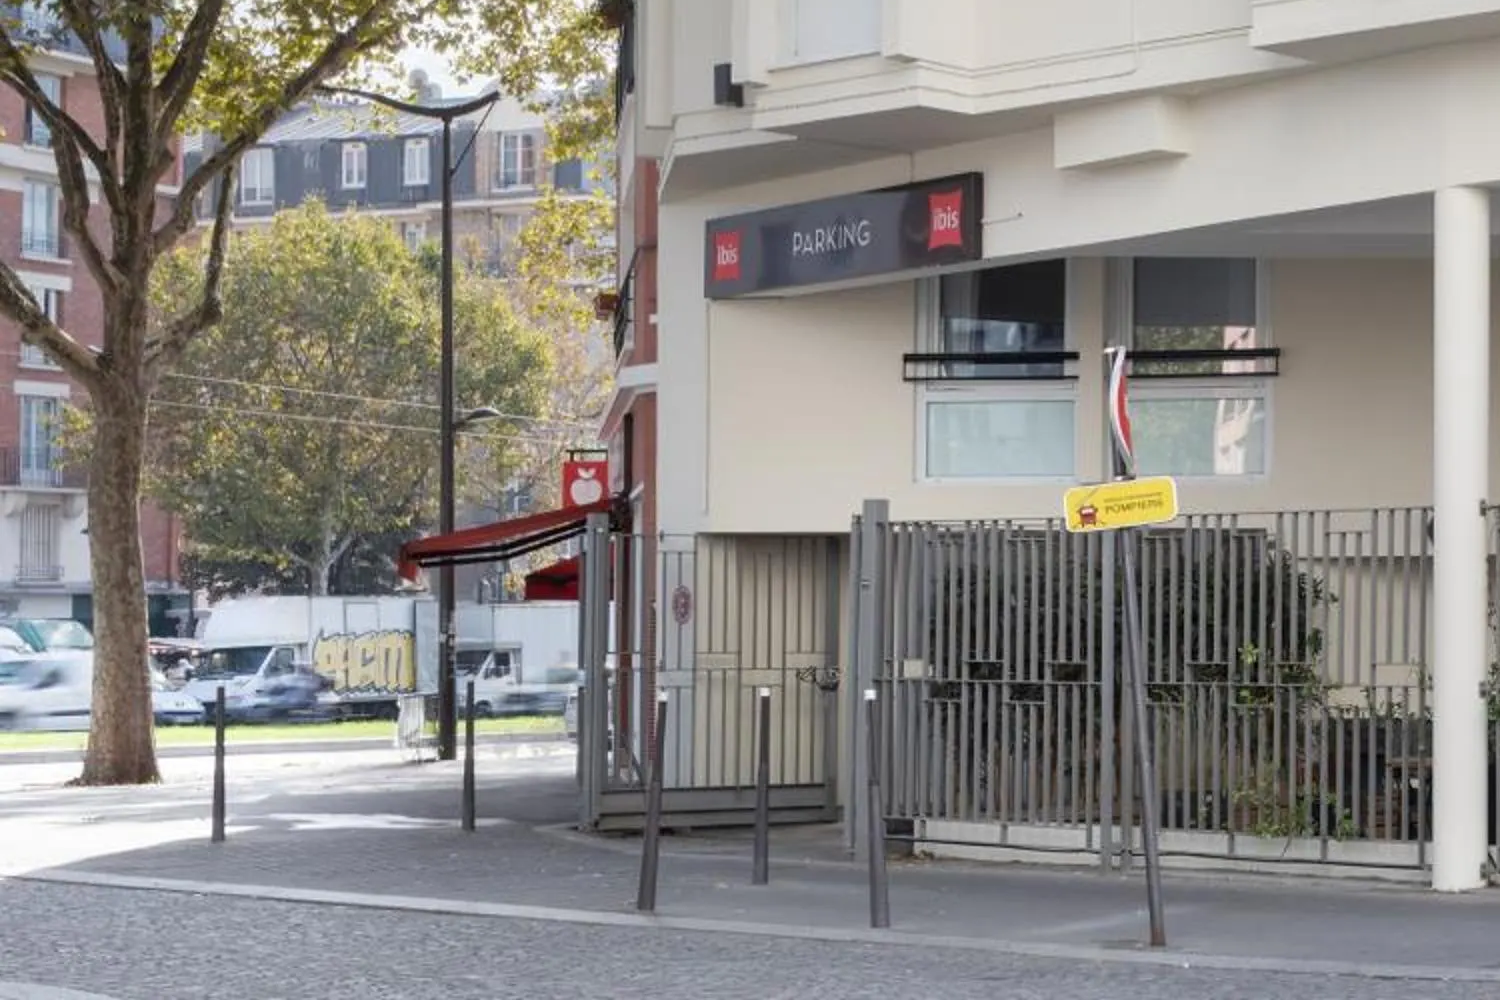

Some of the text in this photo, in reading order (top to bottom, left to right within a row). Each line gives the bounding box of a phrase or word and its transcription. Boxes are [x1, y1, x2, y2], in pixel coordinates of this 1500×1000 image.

[932, 206, 960, 231] ibis
[793, 219, 872, 257] PARKING
[716, 244, 738, 266] ibis
